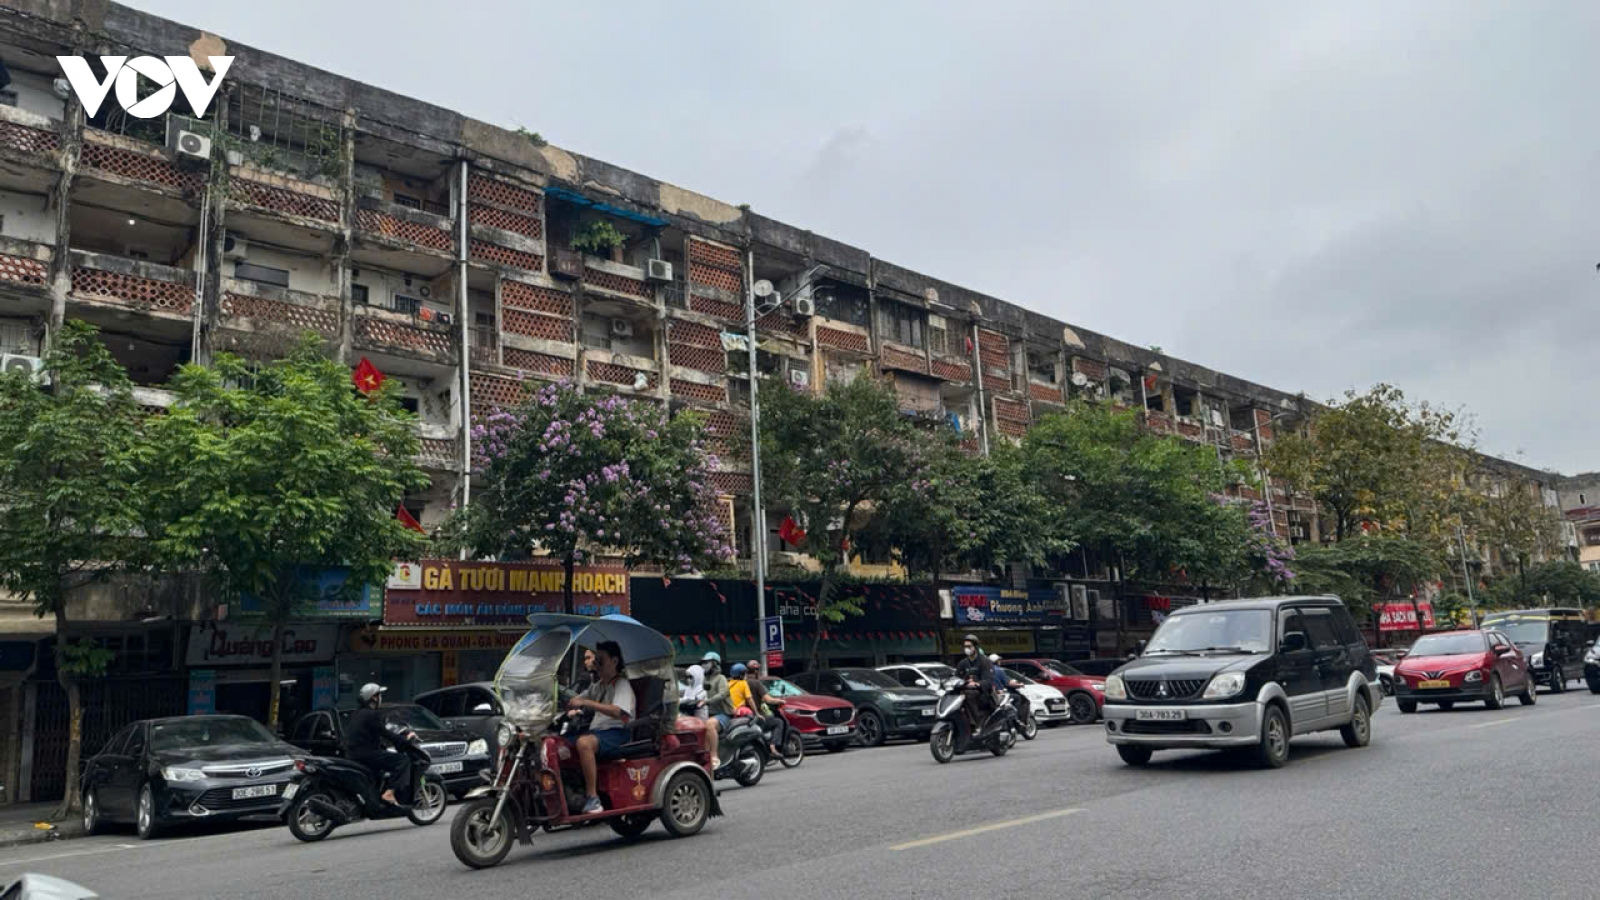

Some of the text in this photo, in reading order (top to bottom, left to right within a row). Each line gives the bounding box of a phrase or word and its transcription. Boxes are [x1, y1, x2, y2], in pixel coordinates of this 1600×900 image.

[424, 563, 454, 590] GÀ
[572, 572, 626, 597] HOẠCH
[779, 600, 800, 616] aha
[769, 624, 778, 642] P
